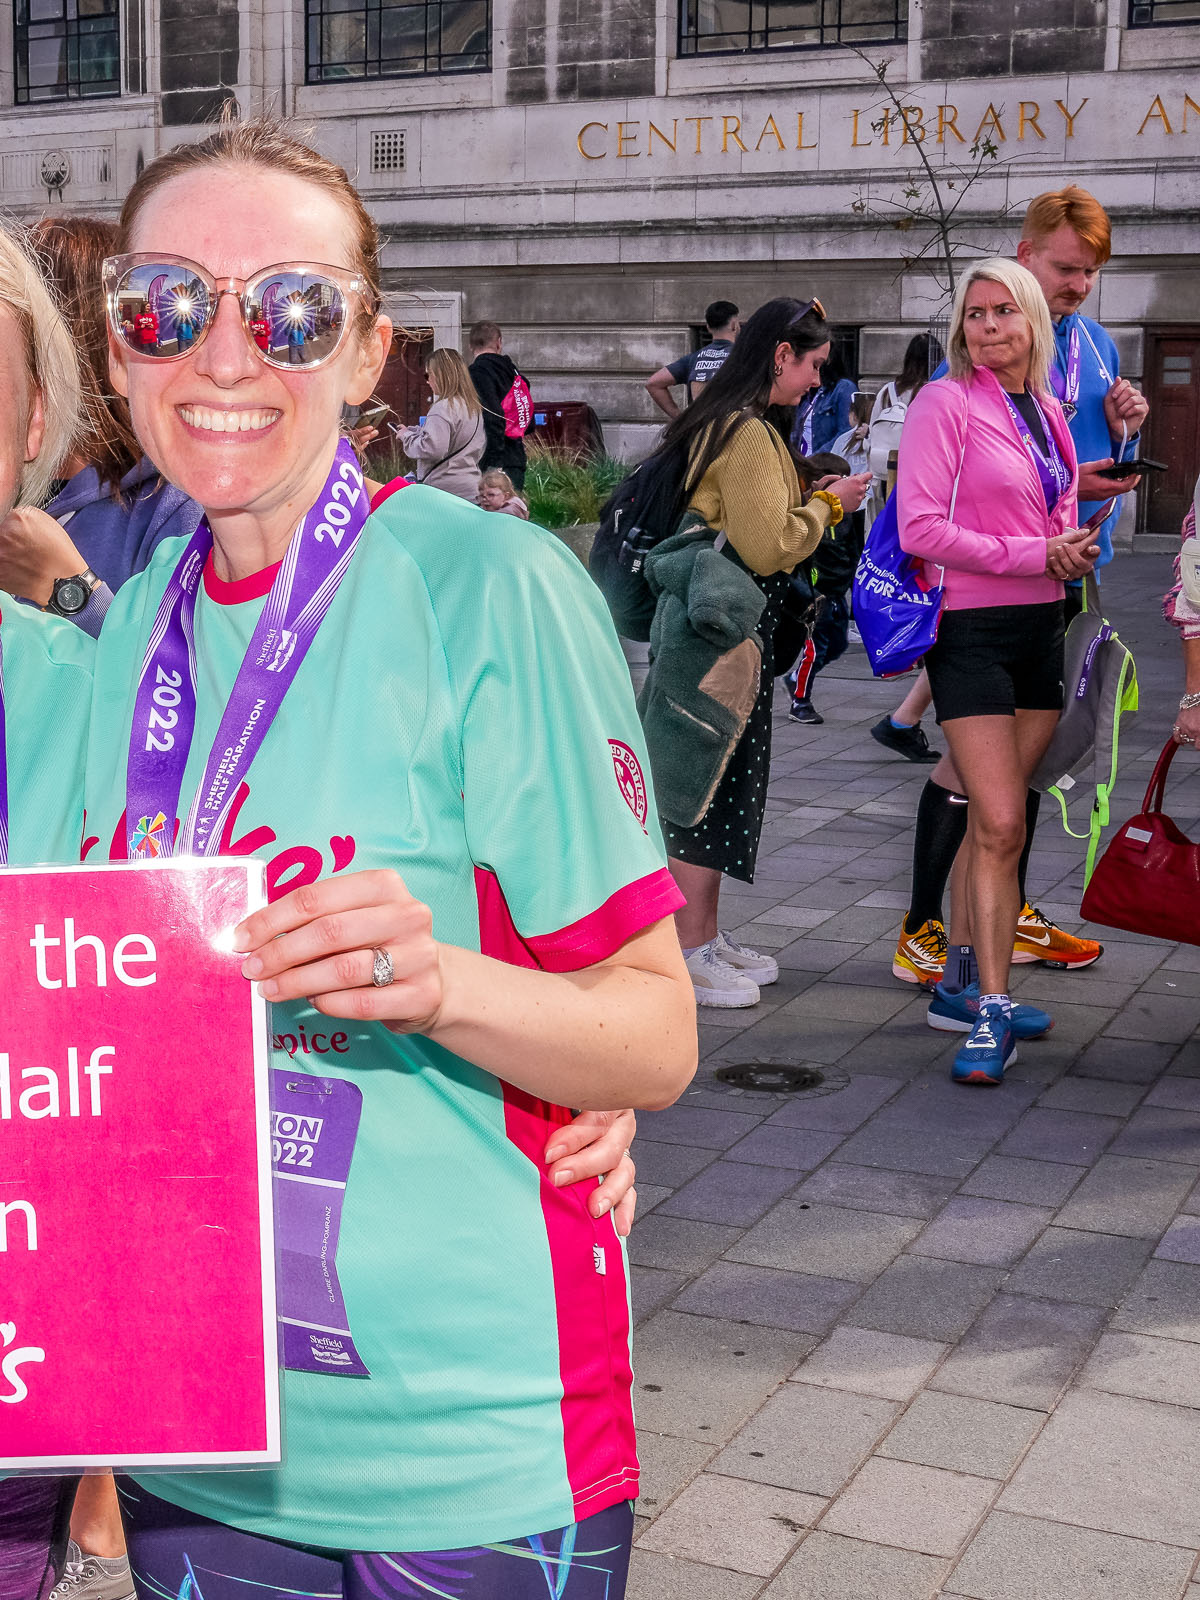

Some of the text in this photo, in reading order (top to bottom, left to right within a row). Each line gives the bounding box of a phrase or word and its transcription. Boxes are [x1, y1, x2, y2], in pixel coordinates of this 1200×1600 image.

[577, 112, 818, 161] CENTRAL
[851, 97, 1091, 147] LIBRARY
[314, 461, 364, 549] 2022
[865, 577, 896, 598] FOR
[256, 629, 277, 666] Sheffield
[145, 665, 183, 752] 2022
[204, 746, 234, 809] SHEFFIELD
[212, 698, 267, 811] HALF MARATHON
[624, 753, 644, 811] BOTTLES
[29, 918, 157, 989] the
[310, 1335, 343, 1348] Sheffield
